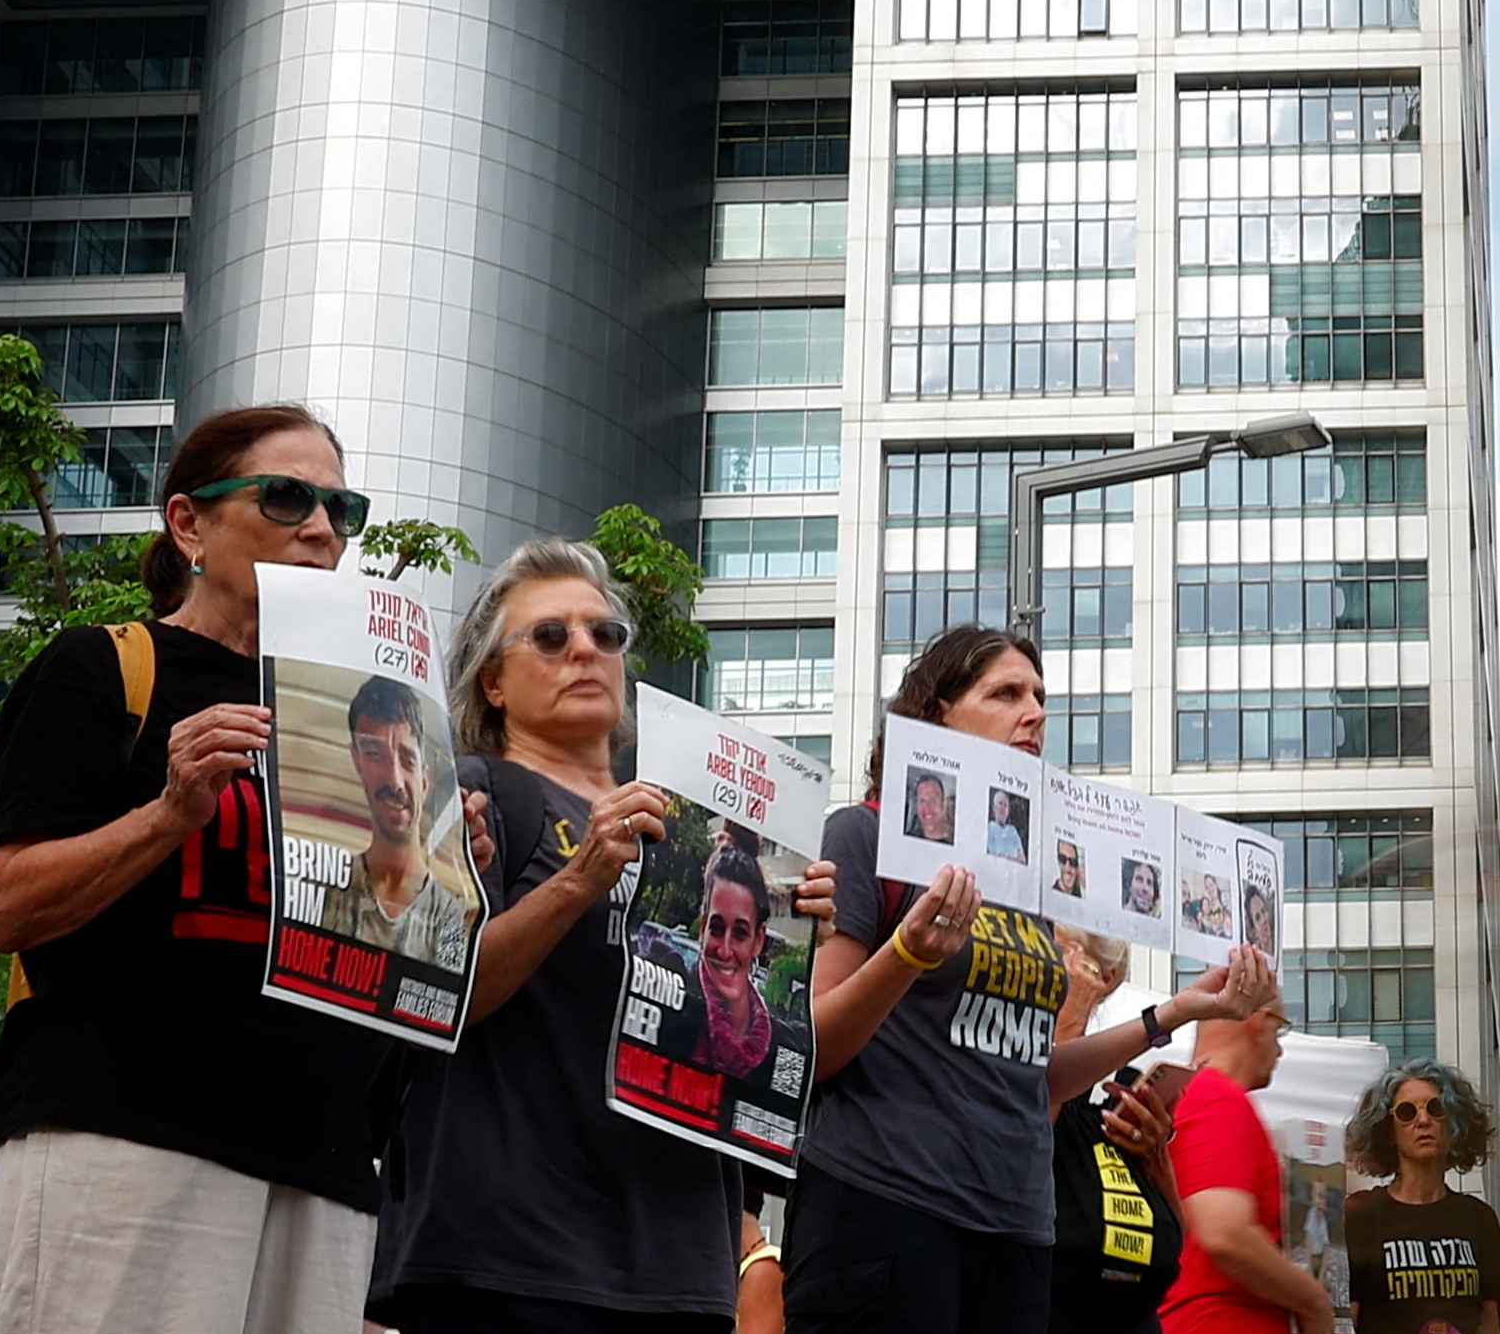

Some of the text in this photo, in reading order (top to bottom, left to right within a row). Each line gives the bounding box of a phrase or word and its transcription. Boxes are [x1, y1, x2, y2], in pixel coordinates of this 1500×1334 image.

[369, 589, 402, 619] קוניו
[368, 614, 404, 644] ARIEL
[375, 642, 408, 674] (27)
[706, 751, 737, 784] ARBEL
[740, 765, 776, 802] YEHOUD
[712, 781, 743, 813] (29)
[283, 835, 353, 889] BRING
[283, 877, 327, 927] HIM
[278, 925, 389, 997] HOME NOW!
[965, 941, 1065, 1011] PEOPLE
[630, 955, 687, 1011] BRING
[621, 996, 663, 1047] HER
[1113, 1198, 1145, 1219] HOME
[1114, 1231, 1145, 1256] NOW!
[1383, 1240, 1428, 1269] שנה
